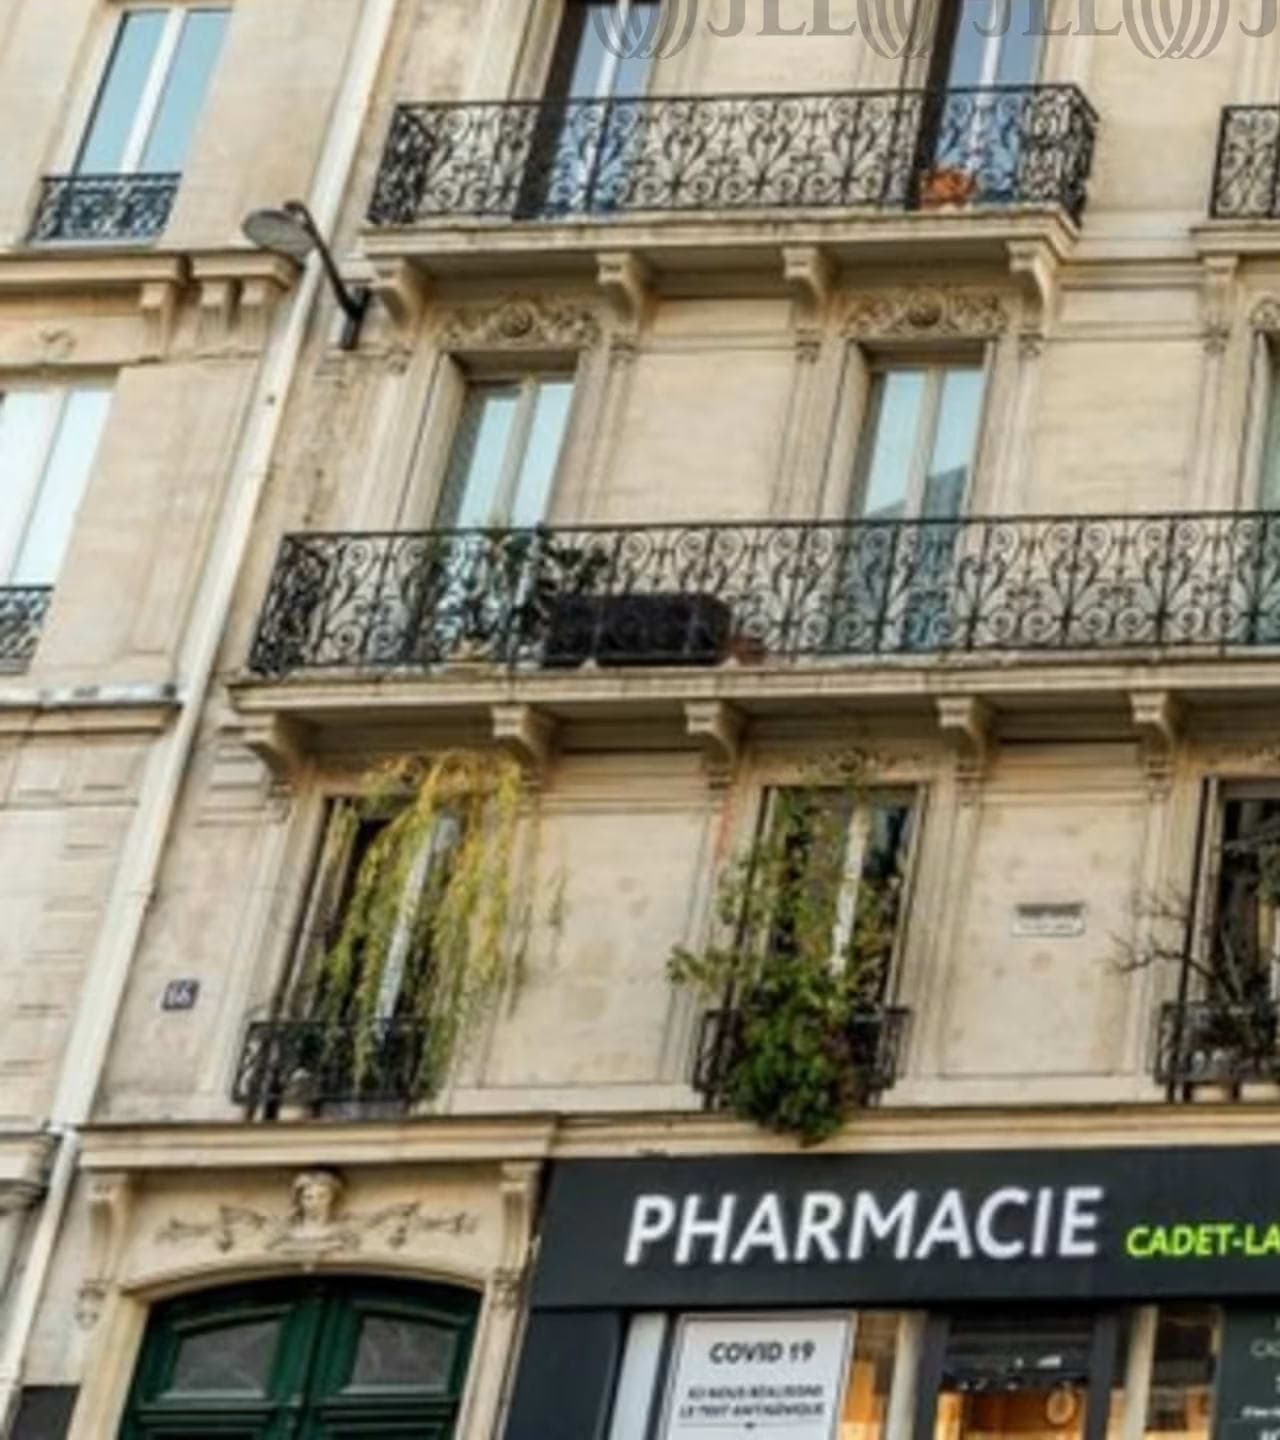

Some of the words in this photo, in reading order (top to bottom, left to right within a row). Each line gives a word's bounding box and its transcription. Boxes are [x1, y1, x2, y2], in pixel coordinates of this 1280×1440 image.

[624, 1185, 1104, 1265] PHARMACIE
[708, 1341, 784, 1365] COVID
[788, 1339, 817, 1363] 19
